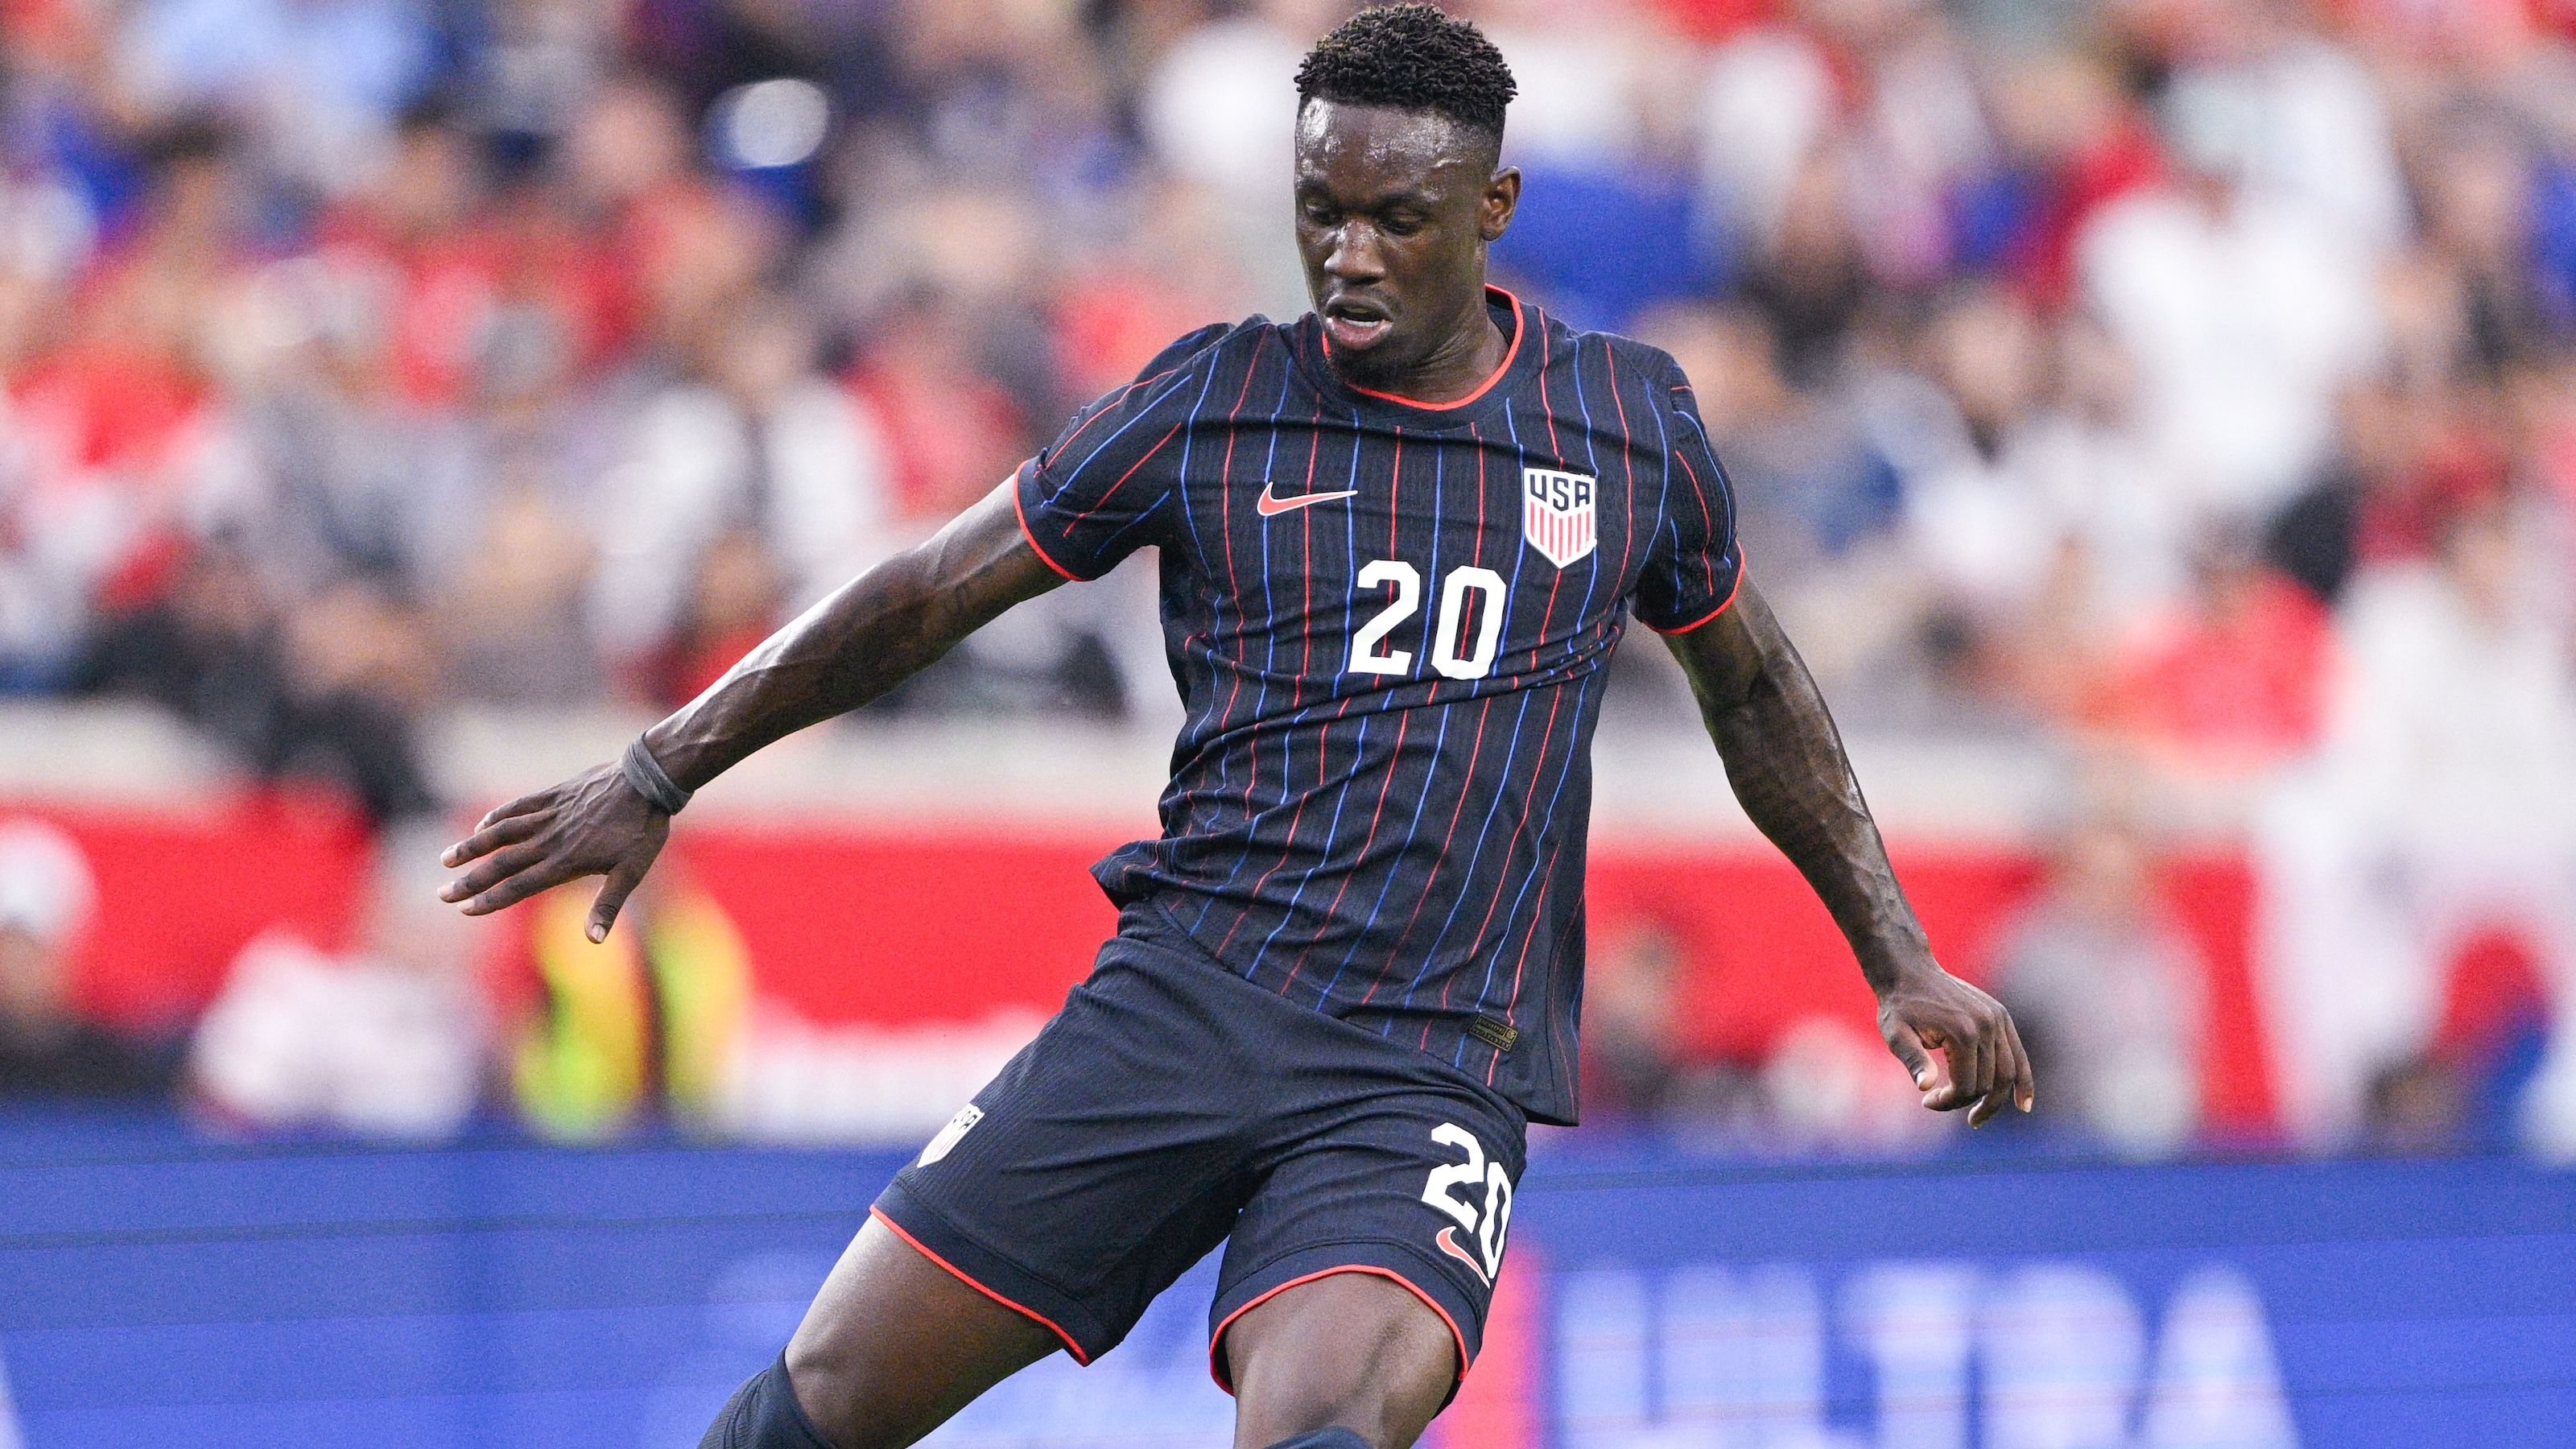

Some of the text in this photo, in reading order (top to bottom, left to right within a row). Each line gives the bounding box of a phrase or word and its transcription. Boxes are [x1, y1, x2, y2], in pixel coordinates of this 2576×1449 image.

[1530, 473, 1591, 511] USA
[1348, 559, 1507, 680] 20
[1421, 1122, 1512, 1279] 20
[1558, 1260, 2301, 1449] ULTRA
